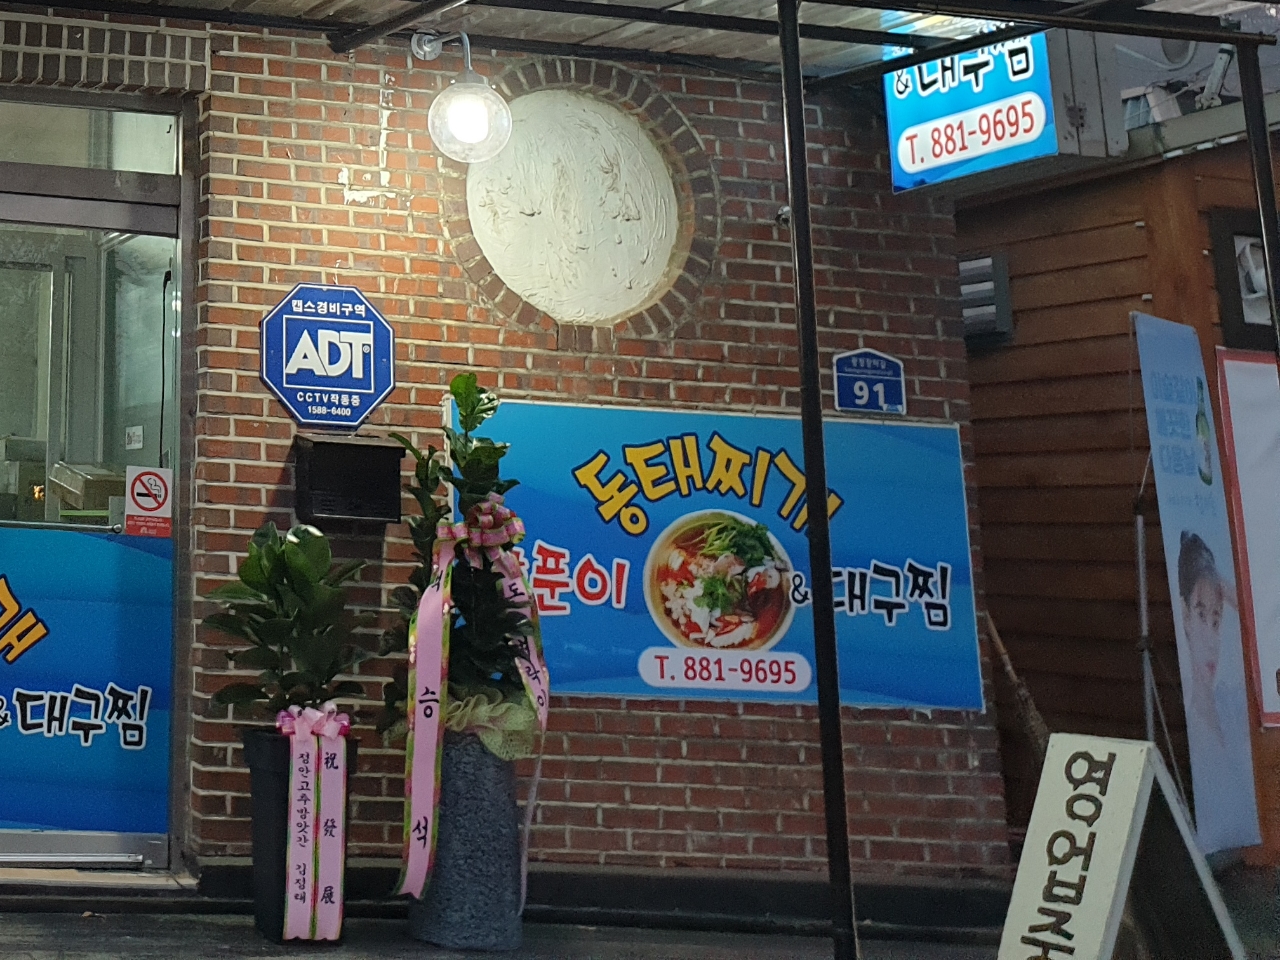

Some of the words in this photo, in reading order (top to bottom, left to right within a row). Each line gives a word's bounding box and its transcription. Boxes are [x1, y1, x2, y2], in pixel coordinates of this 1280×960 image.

[905, 133, 926, 166] T.
[930, 98, 1036, 160] 881-9695
[291, 299, 366, 317] 캡스경비구역
[285, 328, 372, 379] ADT
[296, 391, 361, 407] CCTV작동중
[307, 405, 352, 416] 1588-6400
[853, 380, 885, 407] 91
[510, 539, 630, 615] 푼이
[831, 558, 951, 631] 대구찜
[654, 654, 676, 681] T.
[683, 656, 797, 685] 881-9695
[14, 682, 153, 750] 대구찜
[296, 751, 312, 848] 정안고추방앗간
